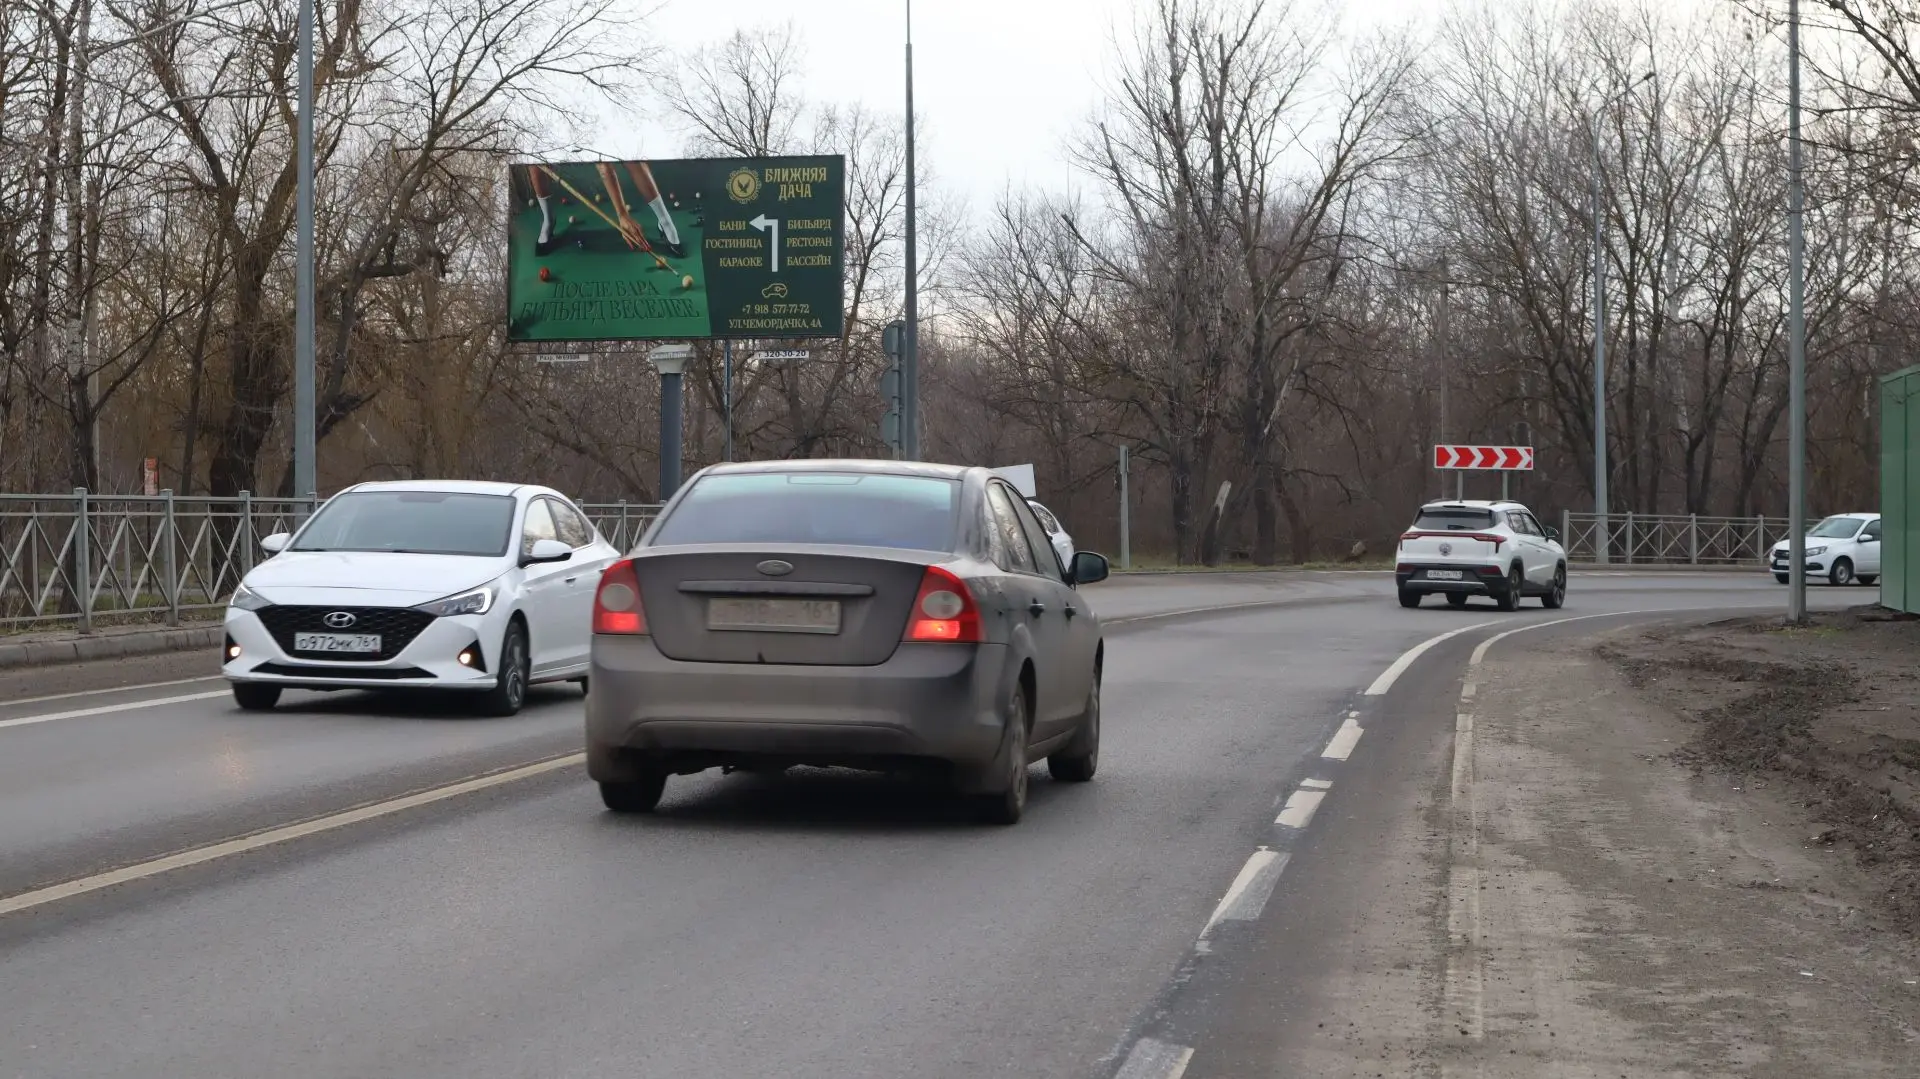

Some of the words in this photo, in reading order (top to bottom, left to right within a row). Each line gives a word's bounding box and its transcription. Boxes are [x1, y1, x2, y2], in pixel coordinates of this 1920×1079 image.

[765, 167, 827, 184] БЛИЖНЯЯ
[778, 184, 812, 201] ДАЧА
[719, 221, 746, 231] БАНИ
[787, 219, 832, 231] БИЛЬЯРД
[705, 238, 763, 250] ГОСТИНИЦА
[787, 237, 832, 248] РЕСТОРАН
[719, 256, 763, 267] КАРАОКЕ
[787, 254, 832, 266] БАССЕЙН
[617, 280, 660, 297] БАРА
[519, 300, 606, 325] БИЛЬЯРД
[610, 298, 700, 320] ВЕСЕЛЕЕ
[742, 304, 751, 314] +7
[754, 304, 769, 314] 918
[772, 304, 810, 314] 577-77-72
[810, 318, 822, 328] 4А
